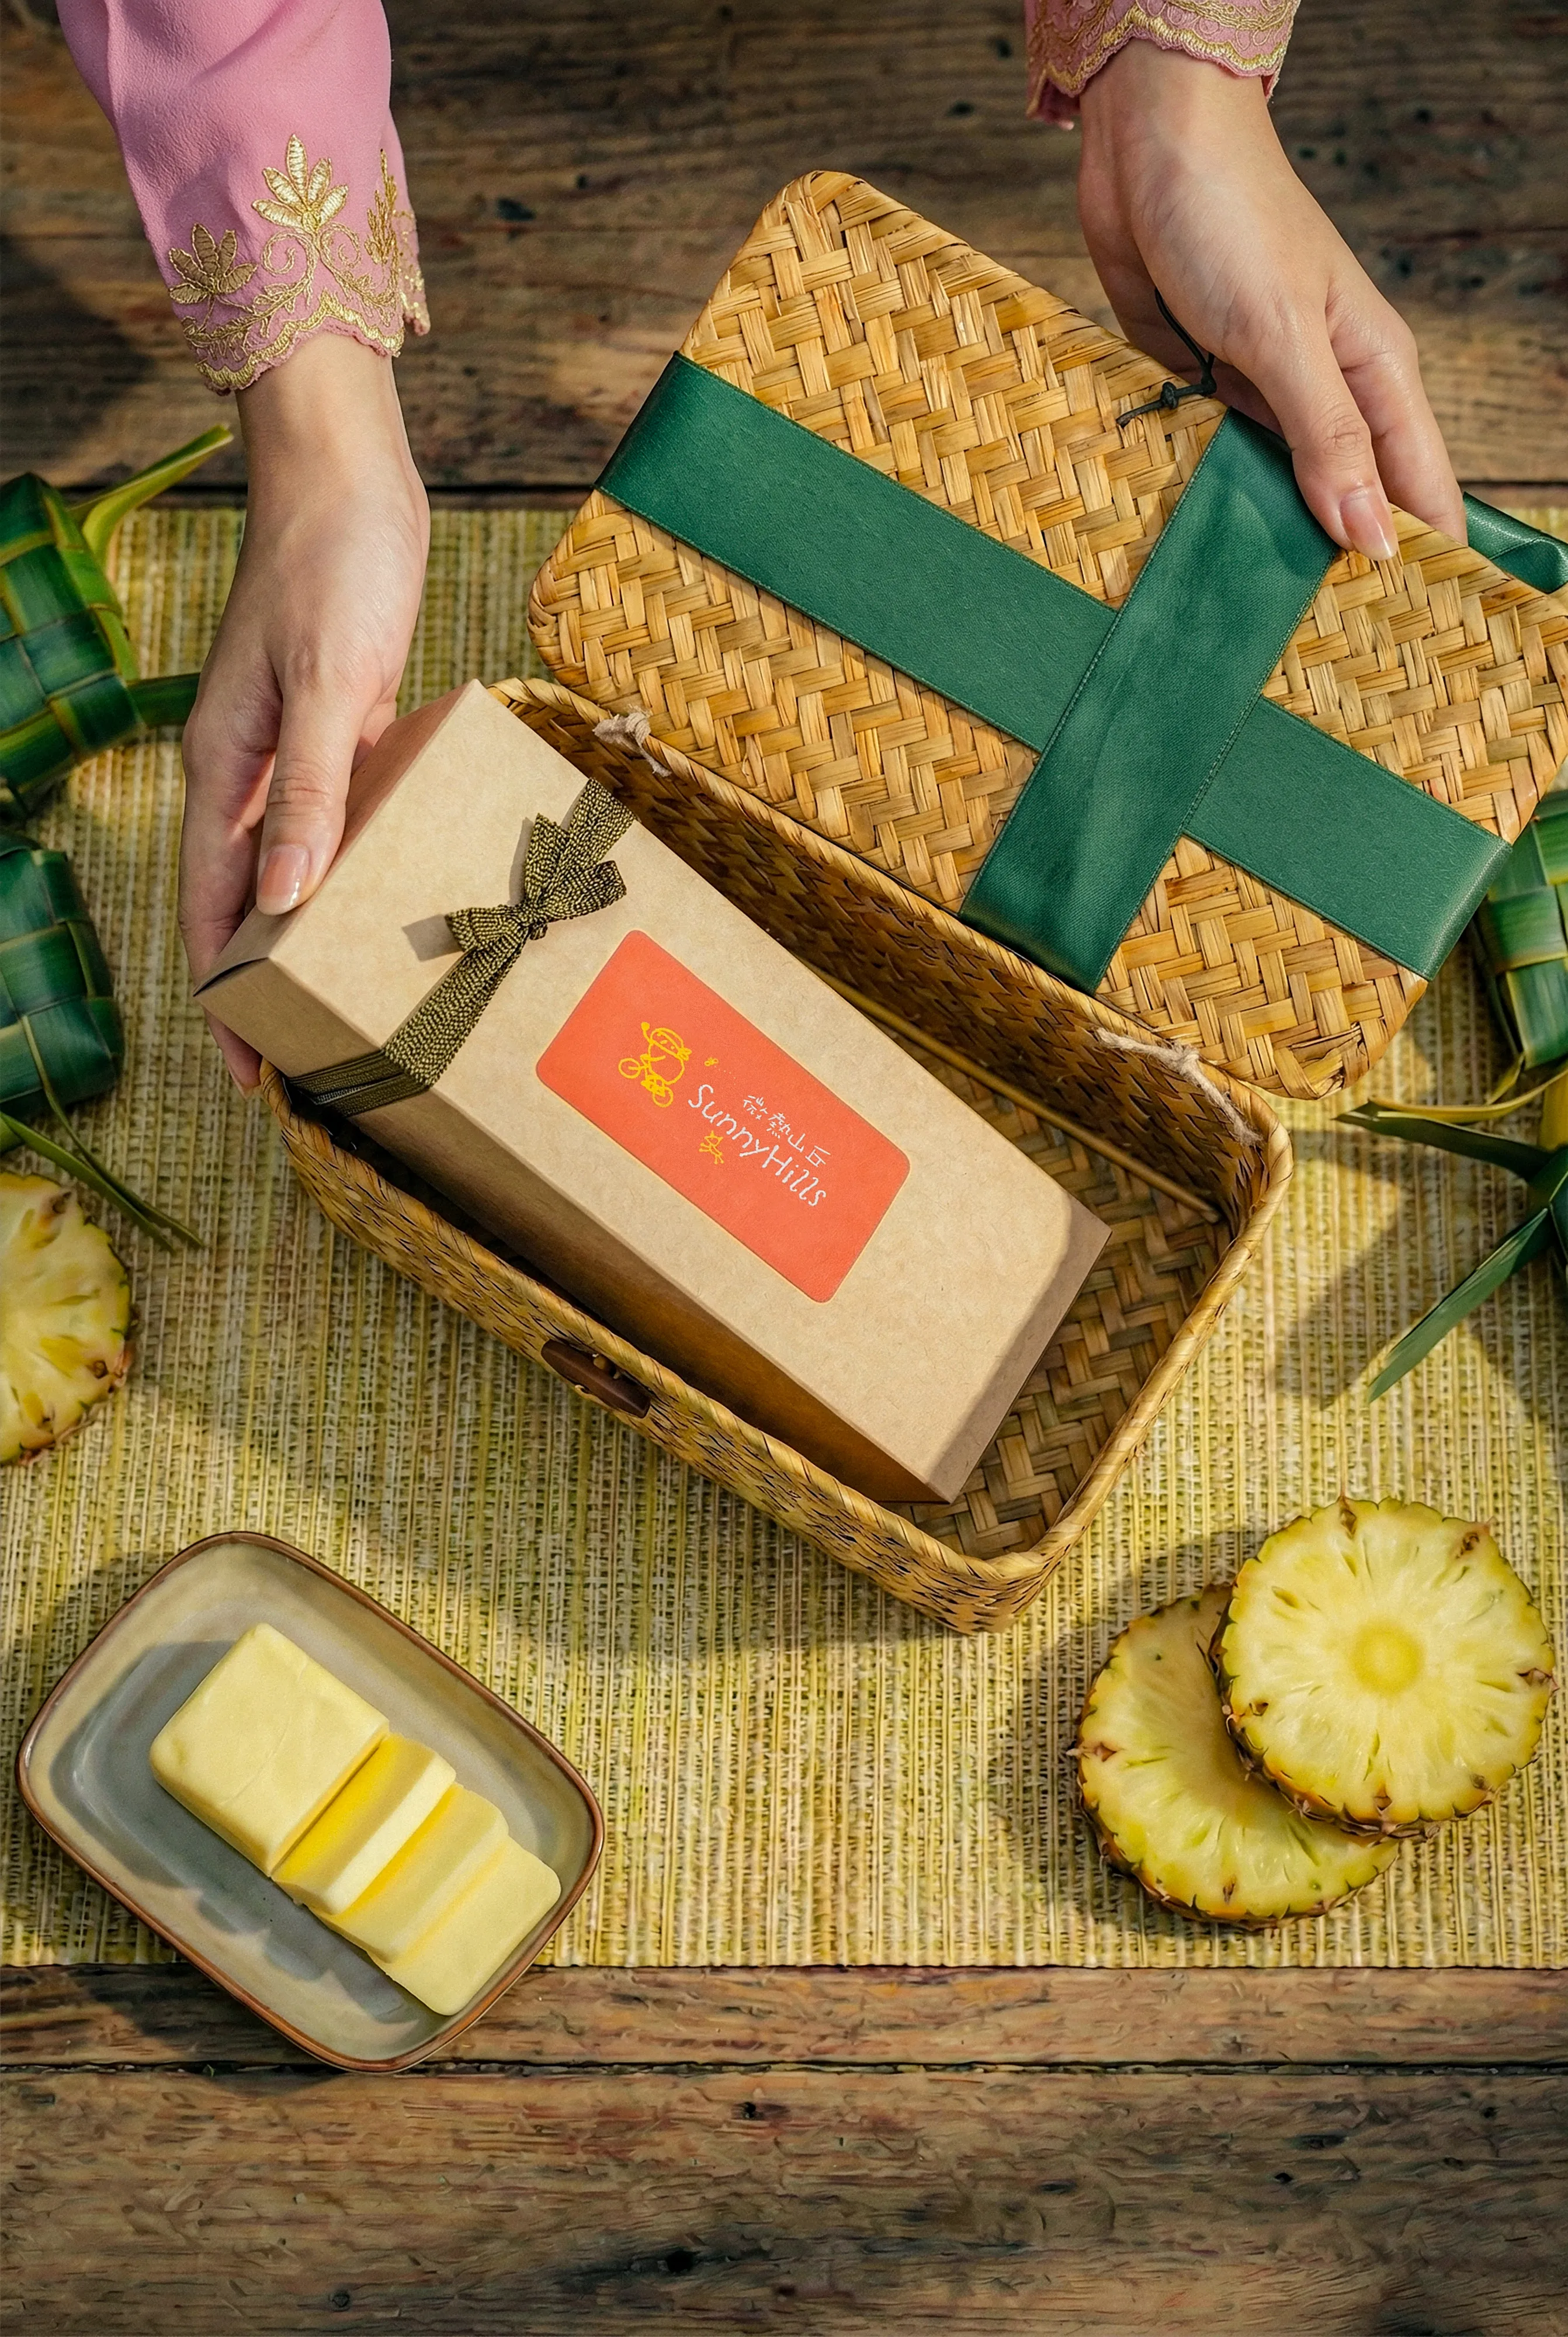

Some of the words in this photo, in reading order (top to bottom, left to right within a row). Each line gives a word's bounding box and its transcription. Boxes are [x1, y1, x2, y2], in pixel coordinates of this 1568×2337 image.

[688, 1084, 827, 1206] SunnyHills
[743, 1095, 831, 1167] 微熱山丘
